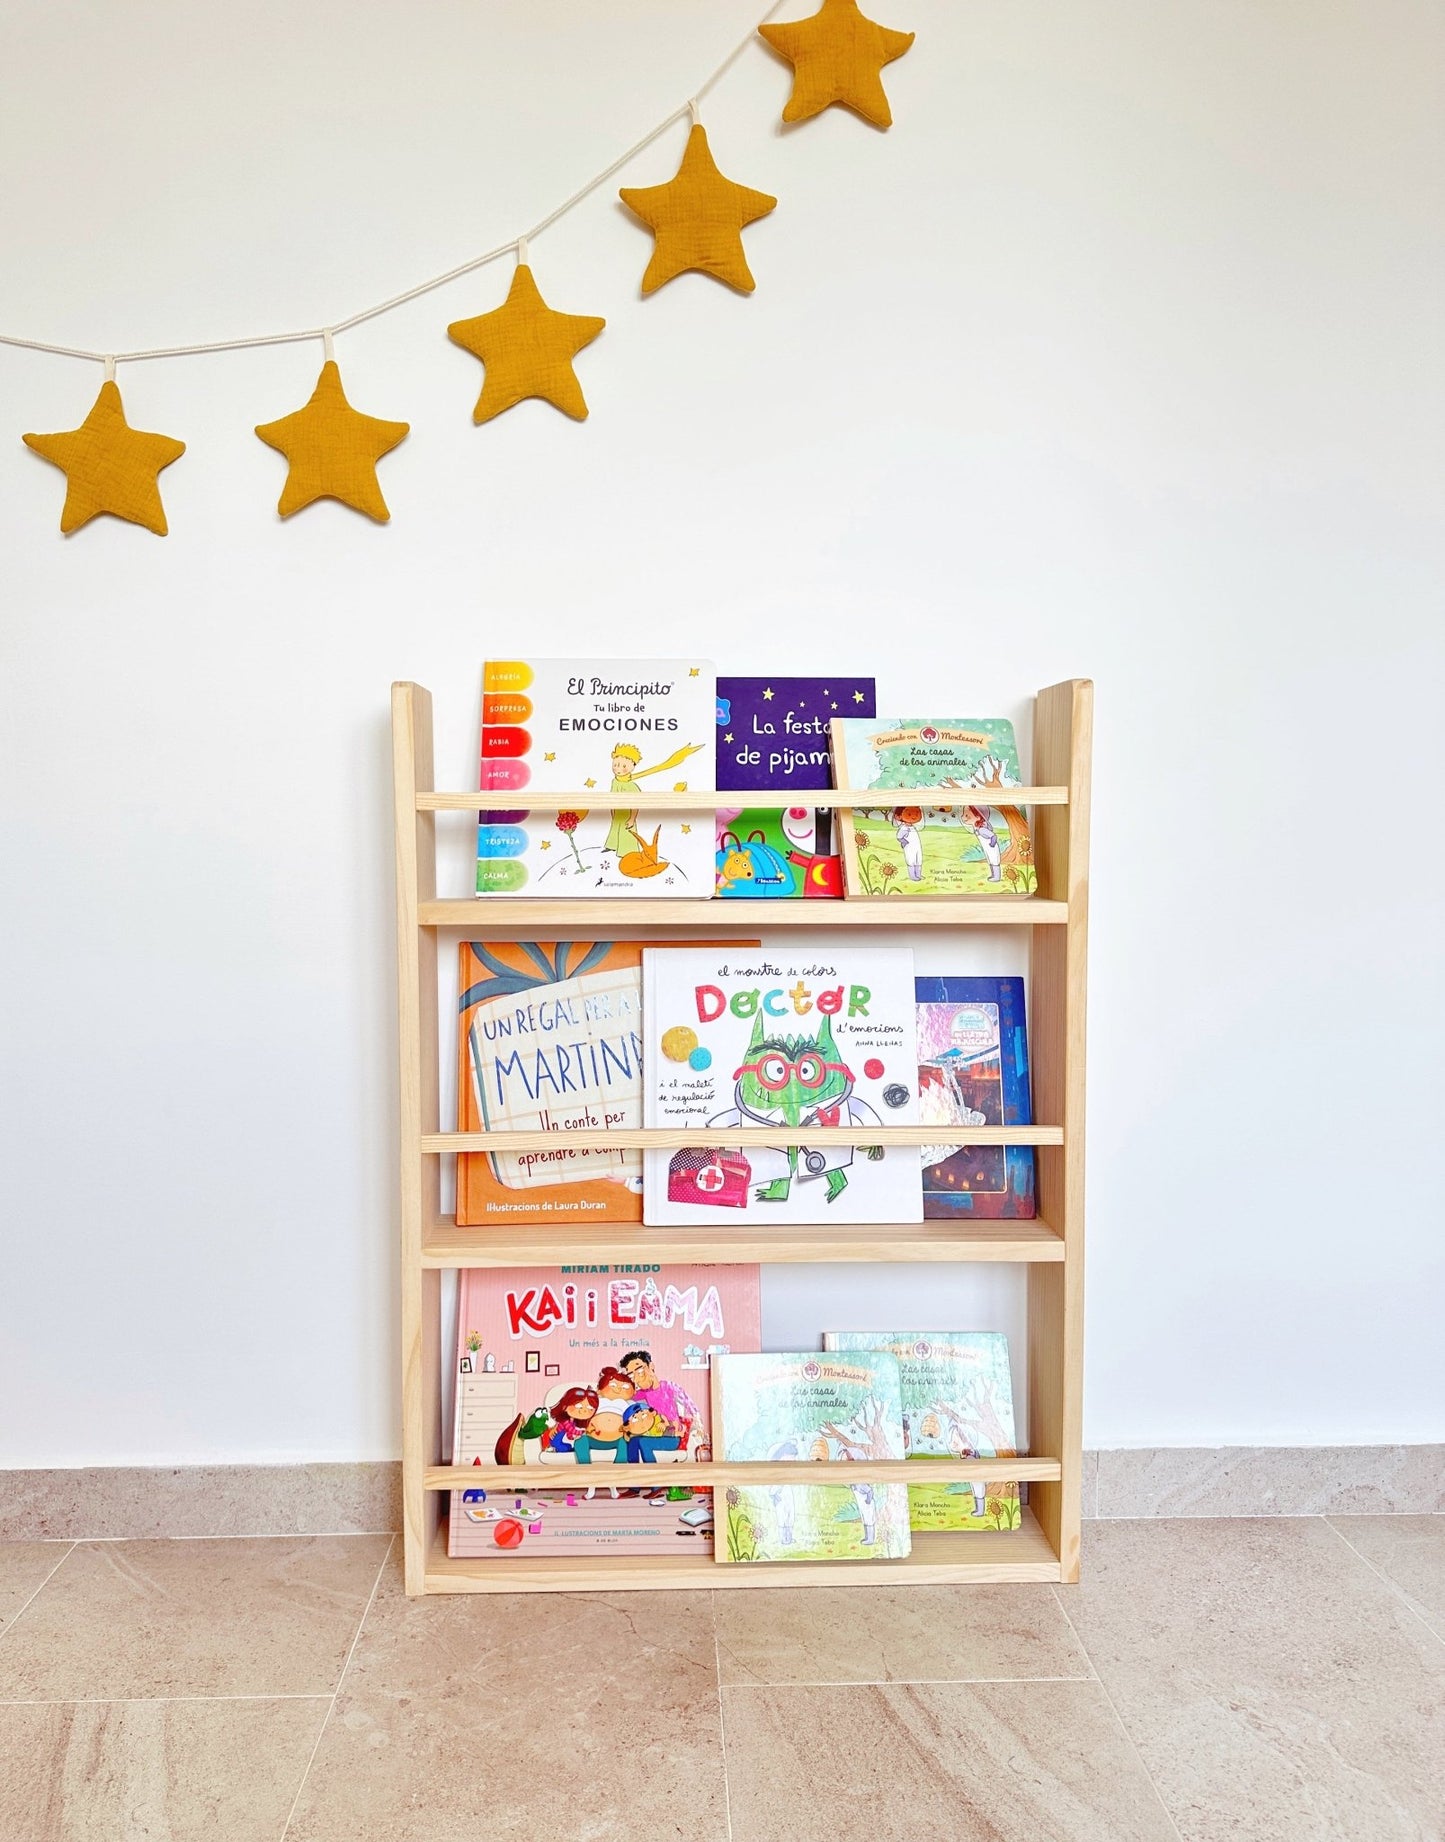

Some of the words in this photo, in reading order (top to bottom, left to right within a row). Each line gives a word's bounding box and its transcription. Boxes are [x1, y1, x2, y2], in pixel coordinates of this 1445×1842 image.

[567, 677, 585, 696] El
[590, 677, 671, 700] Principito
[593, 704, 606, 712] Tu
[608, 702, 631, 712] libro
[633, 702, 645, 712] de
[559, 718, 679, 731] EMOCIONES
[753, 713, 776, 734] La
[488, 738, 510, 747] RABIA
[941, 732, 984, 745] Montessori
[736, 744, 761, 765] de
[910, 747, 927, 756] Las
[899, 758, 910, 766] de
[911, 758, 925, 766] los
[927, 758, 967, 766] animales
[487, 771, 510, 779] AMOR
[485, 838, 520, 846] TRISTEZA
[483, 872, 509, 880] CALMA
[717, 965, 729, 977] el
[734, 962, 783, 976] monstre
[787, 966, 798, 976] de
[802, 965, 837, 977] colors
[483, 1016, 512, 1040] UN
[516, 998, 580, 1034] REGAL
[836, 1022, 904, 1034] d'emocions
[659, 1080, 665, 1088] i
[669, 1078, 678, 1088] el
[671, 1090, 715, 1105] regulació
[664, 1106, 710, 1114] emocional
[564, 1106, 599, 1130] conte
[604, 1111, 626, 1130] per
[541, 1201, 553, 1211] de
[554, 1201, 579, 1210] Laura
[580, 1200, 606, 1210] Duran
[561, 1264, 609, 1273] MIRIAM
[613, 1263, 661, 1273] TIRADO
[587, 1291, 596, 1322] i
[568, 1338, 580, 1347] Un
[583, 1338, 599, 1347] més
[610, 1338, 618, 1347] la
[823, 1367, 868, 1381] Montessori
[807, 1398, 849, 1407] animales
